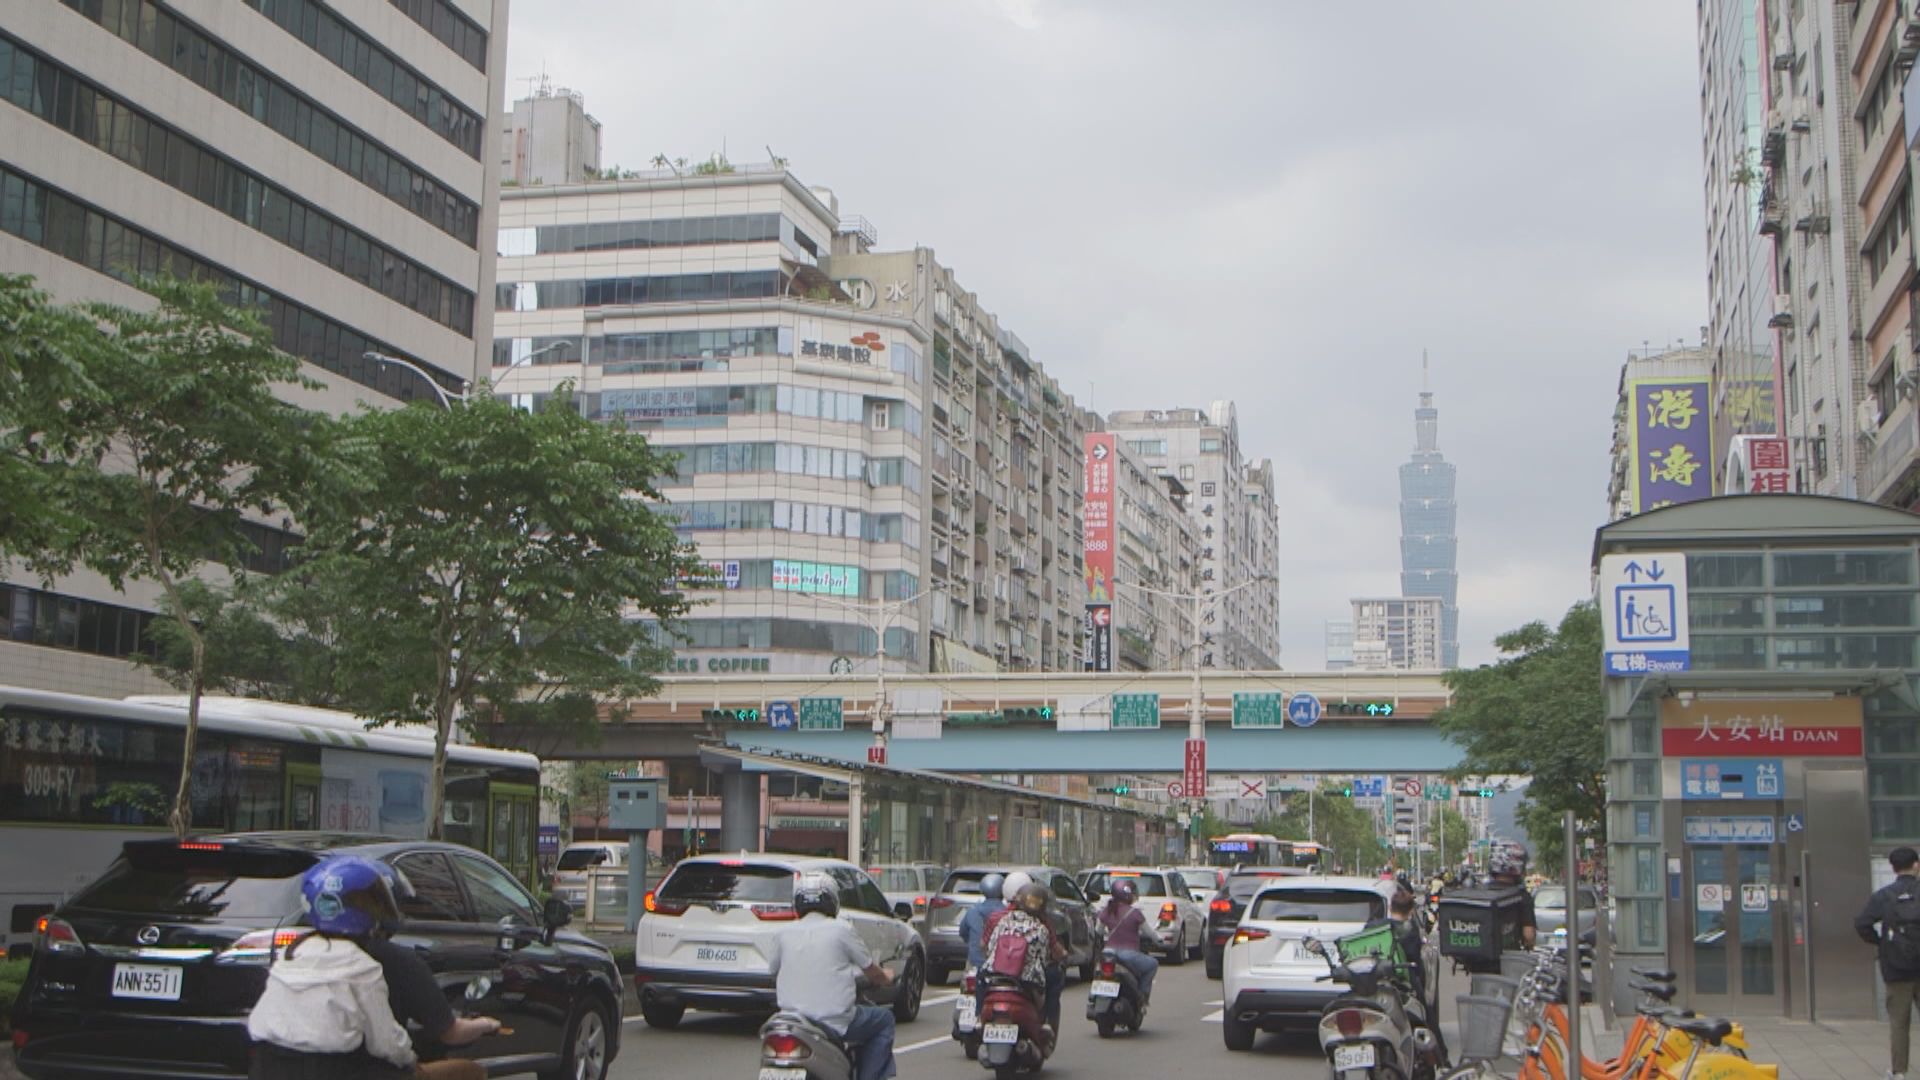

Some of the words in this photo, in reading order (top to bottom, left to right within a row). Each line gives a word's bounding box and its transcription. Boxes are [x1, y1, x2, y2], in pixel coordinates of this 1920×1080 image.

[1647, 659, 1684, 672] Elevator
[1694, 714, 1785, 742] 大安站
[1792, 729, 1839, 743] DAAN
[1449, 919, 1480, 933] Uber
[1449, 933, 1481, 947] Eats
